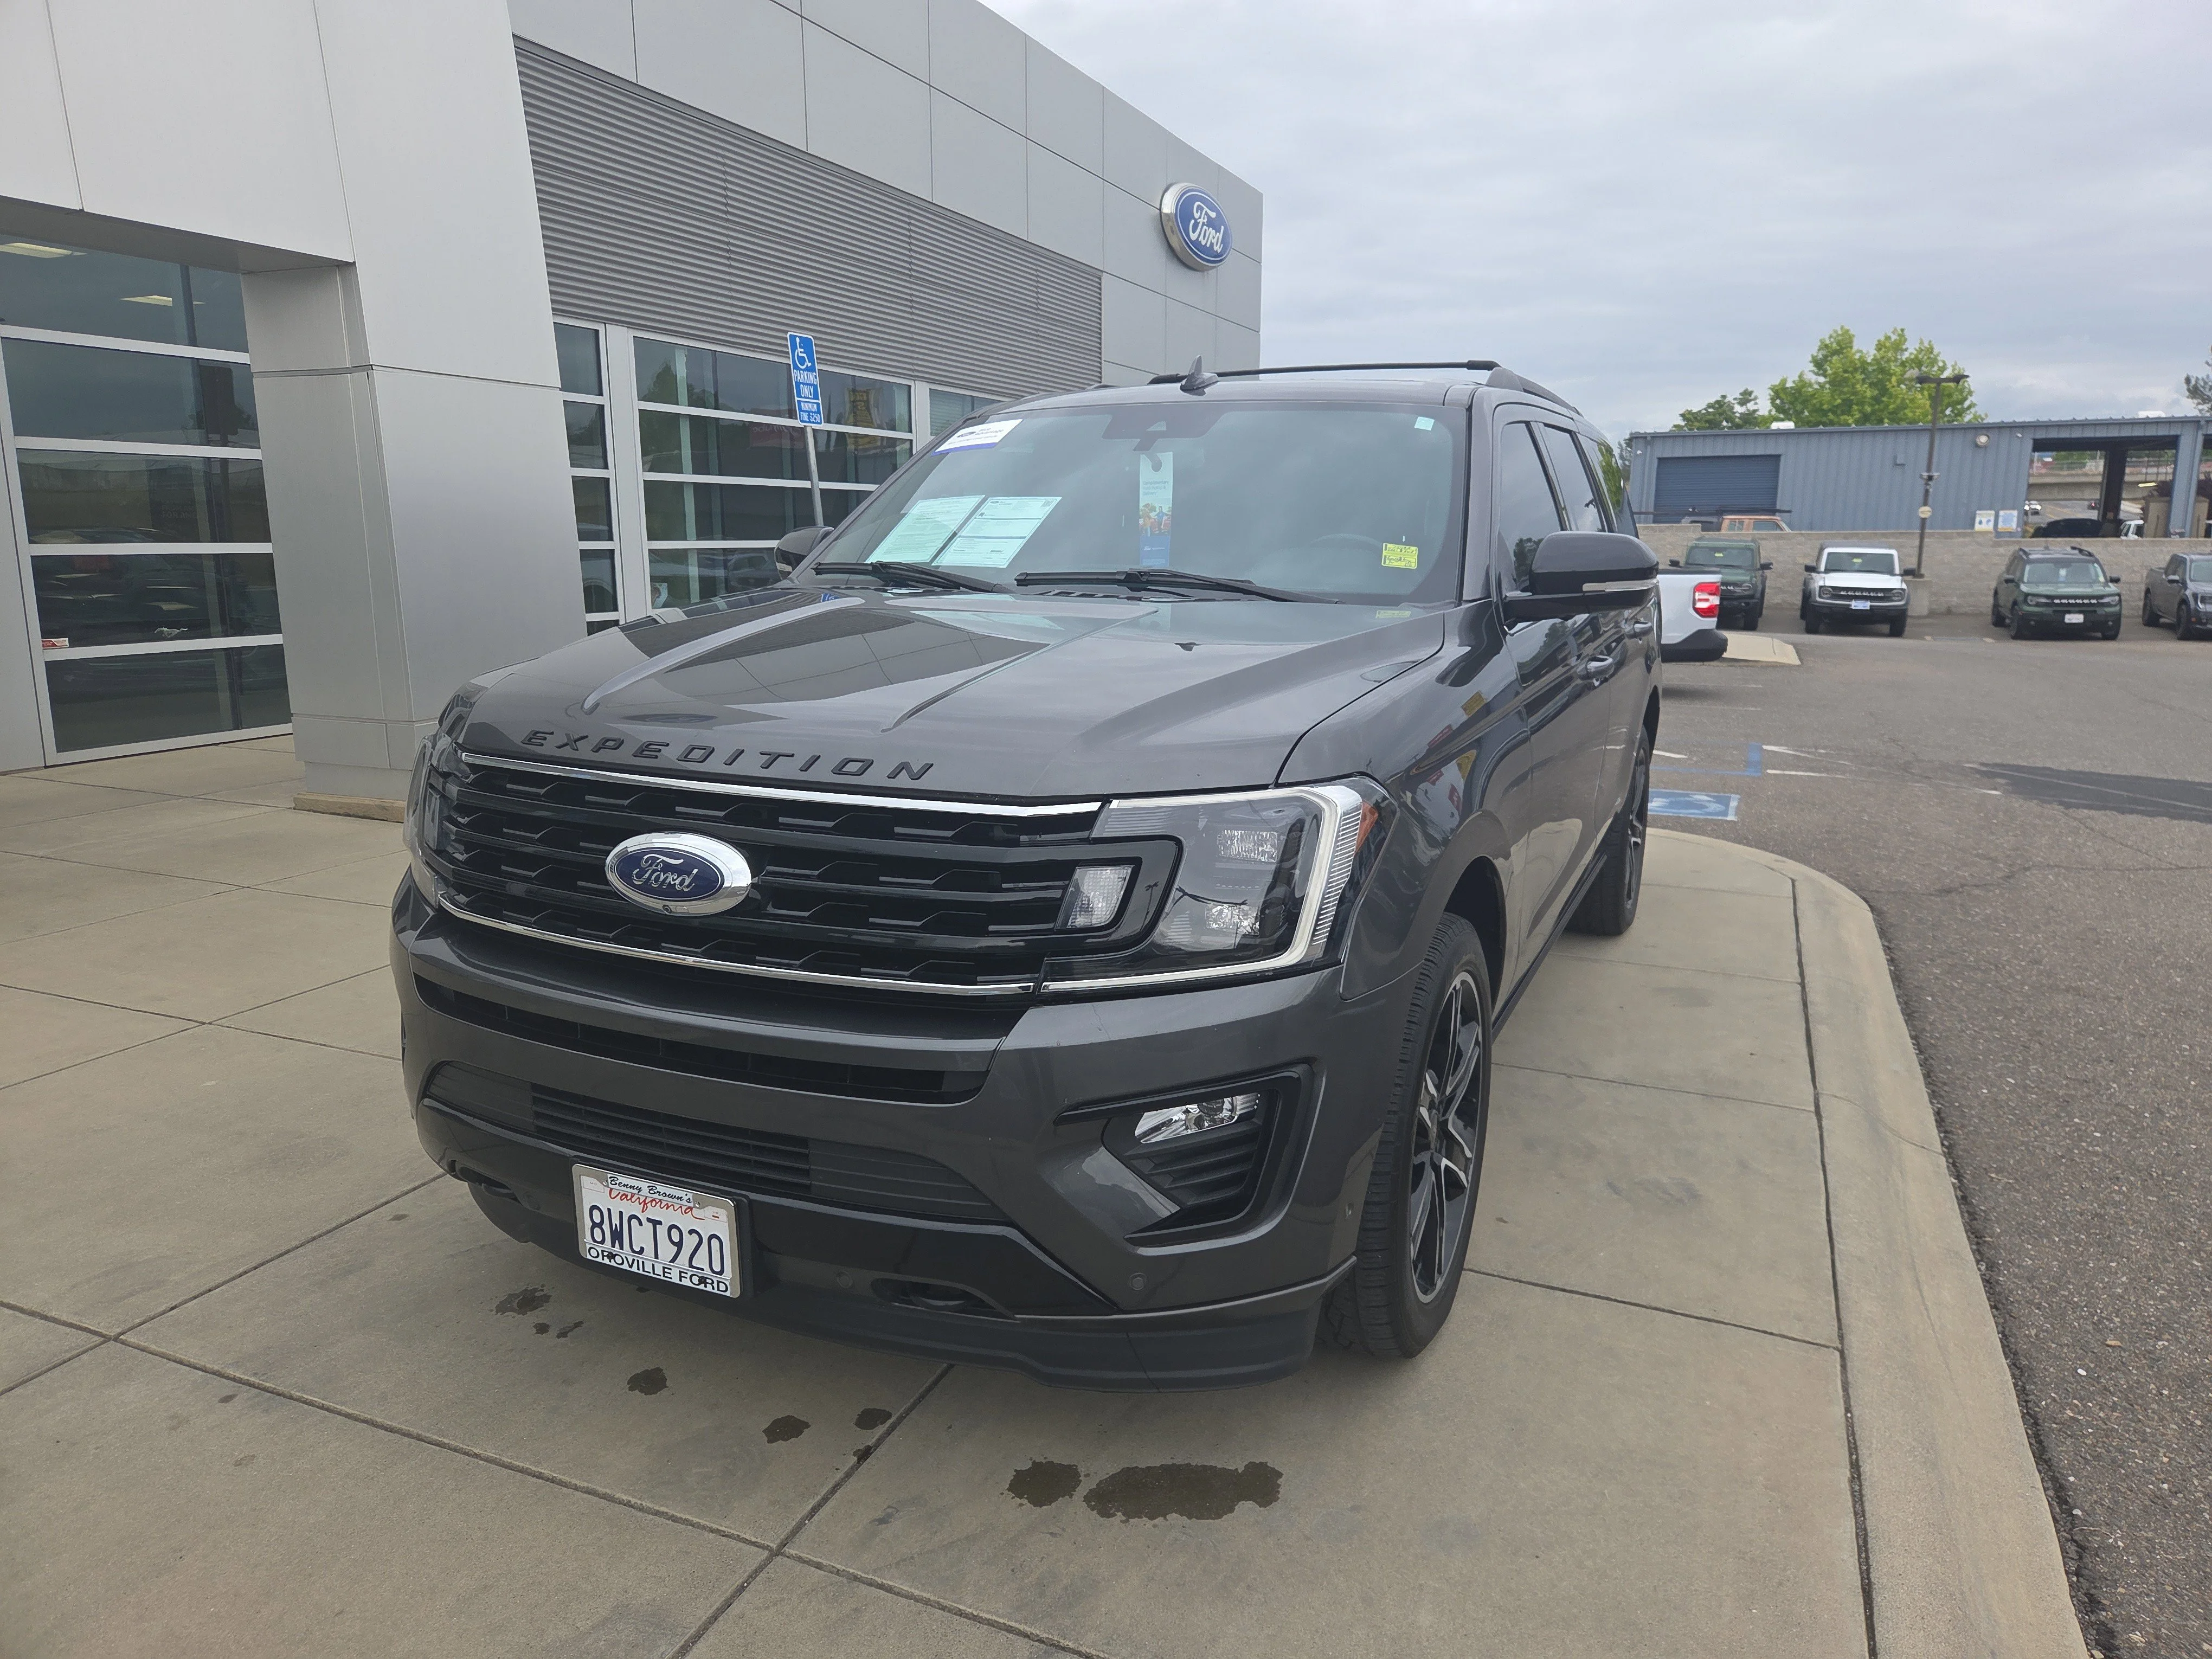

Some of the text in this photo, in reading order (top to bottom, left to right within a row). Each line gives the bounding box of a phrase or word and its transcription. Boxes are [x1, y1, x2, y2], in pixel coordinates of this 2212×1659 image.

[1189, 201, 1224, 253] Ford
[793, 369, 818, 385] PARKING
[800, 384, 814, 398] ONLY
[520, 729, 934, 781] EXPEDITION
[632, 853, 698, 892] Ford
[608, 1176, 692, 1204] Benny Brown's
[608, 1188, 705, 1220] California
[589, 1204, 725, 1276] 8WCT920
[588, 1246, 729, 1294] OROVILLE FORD
